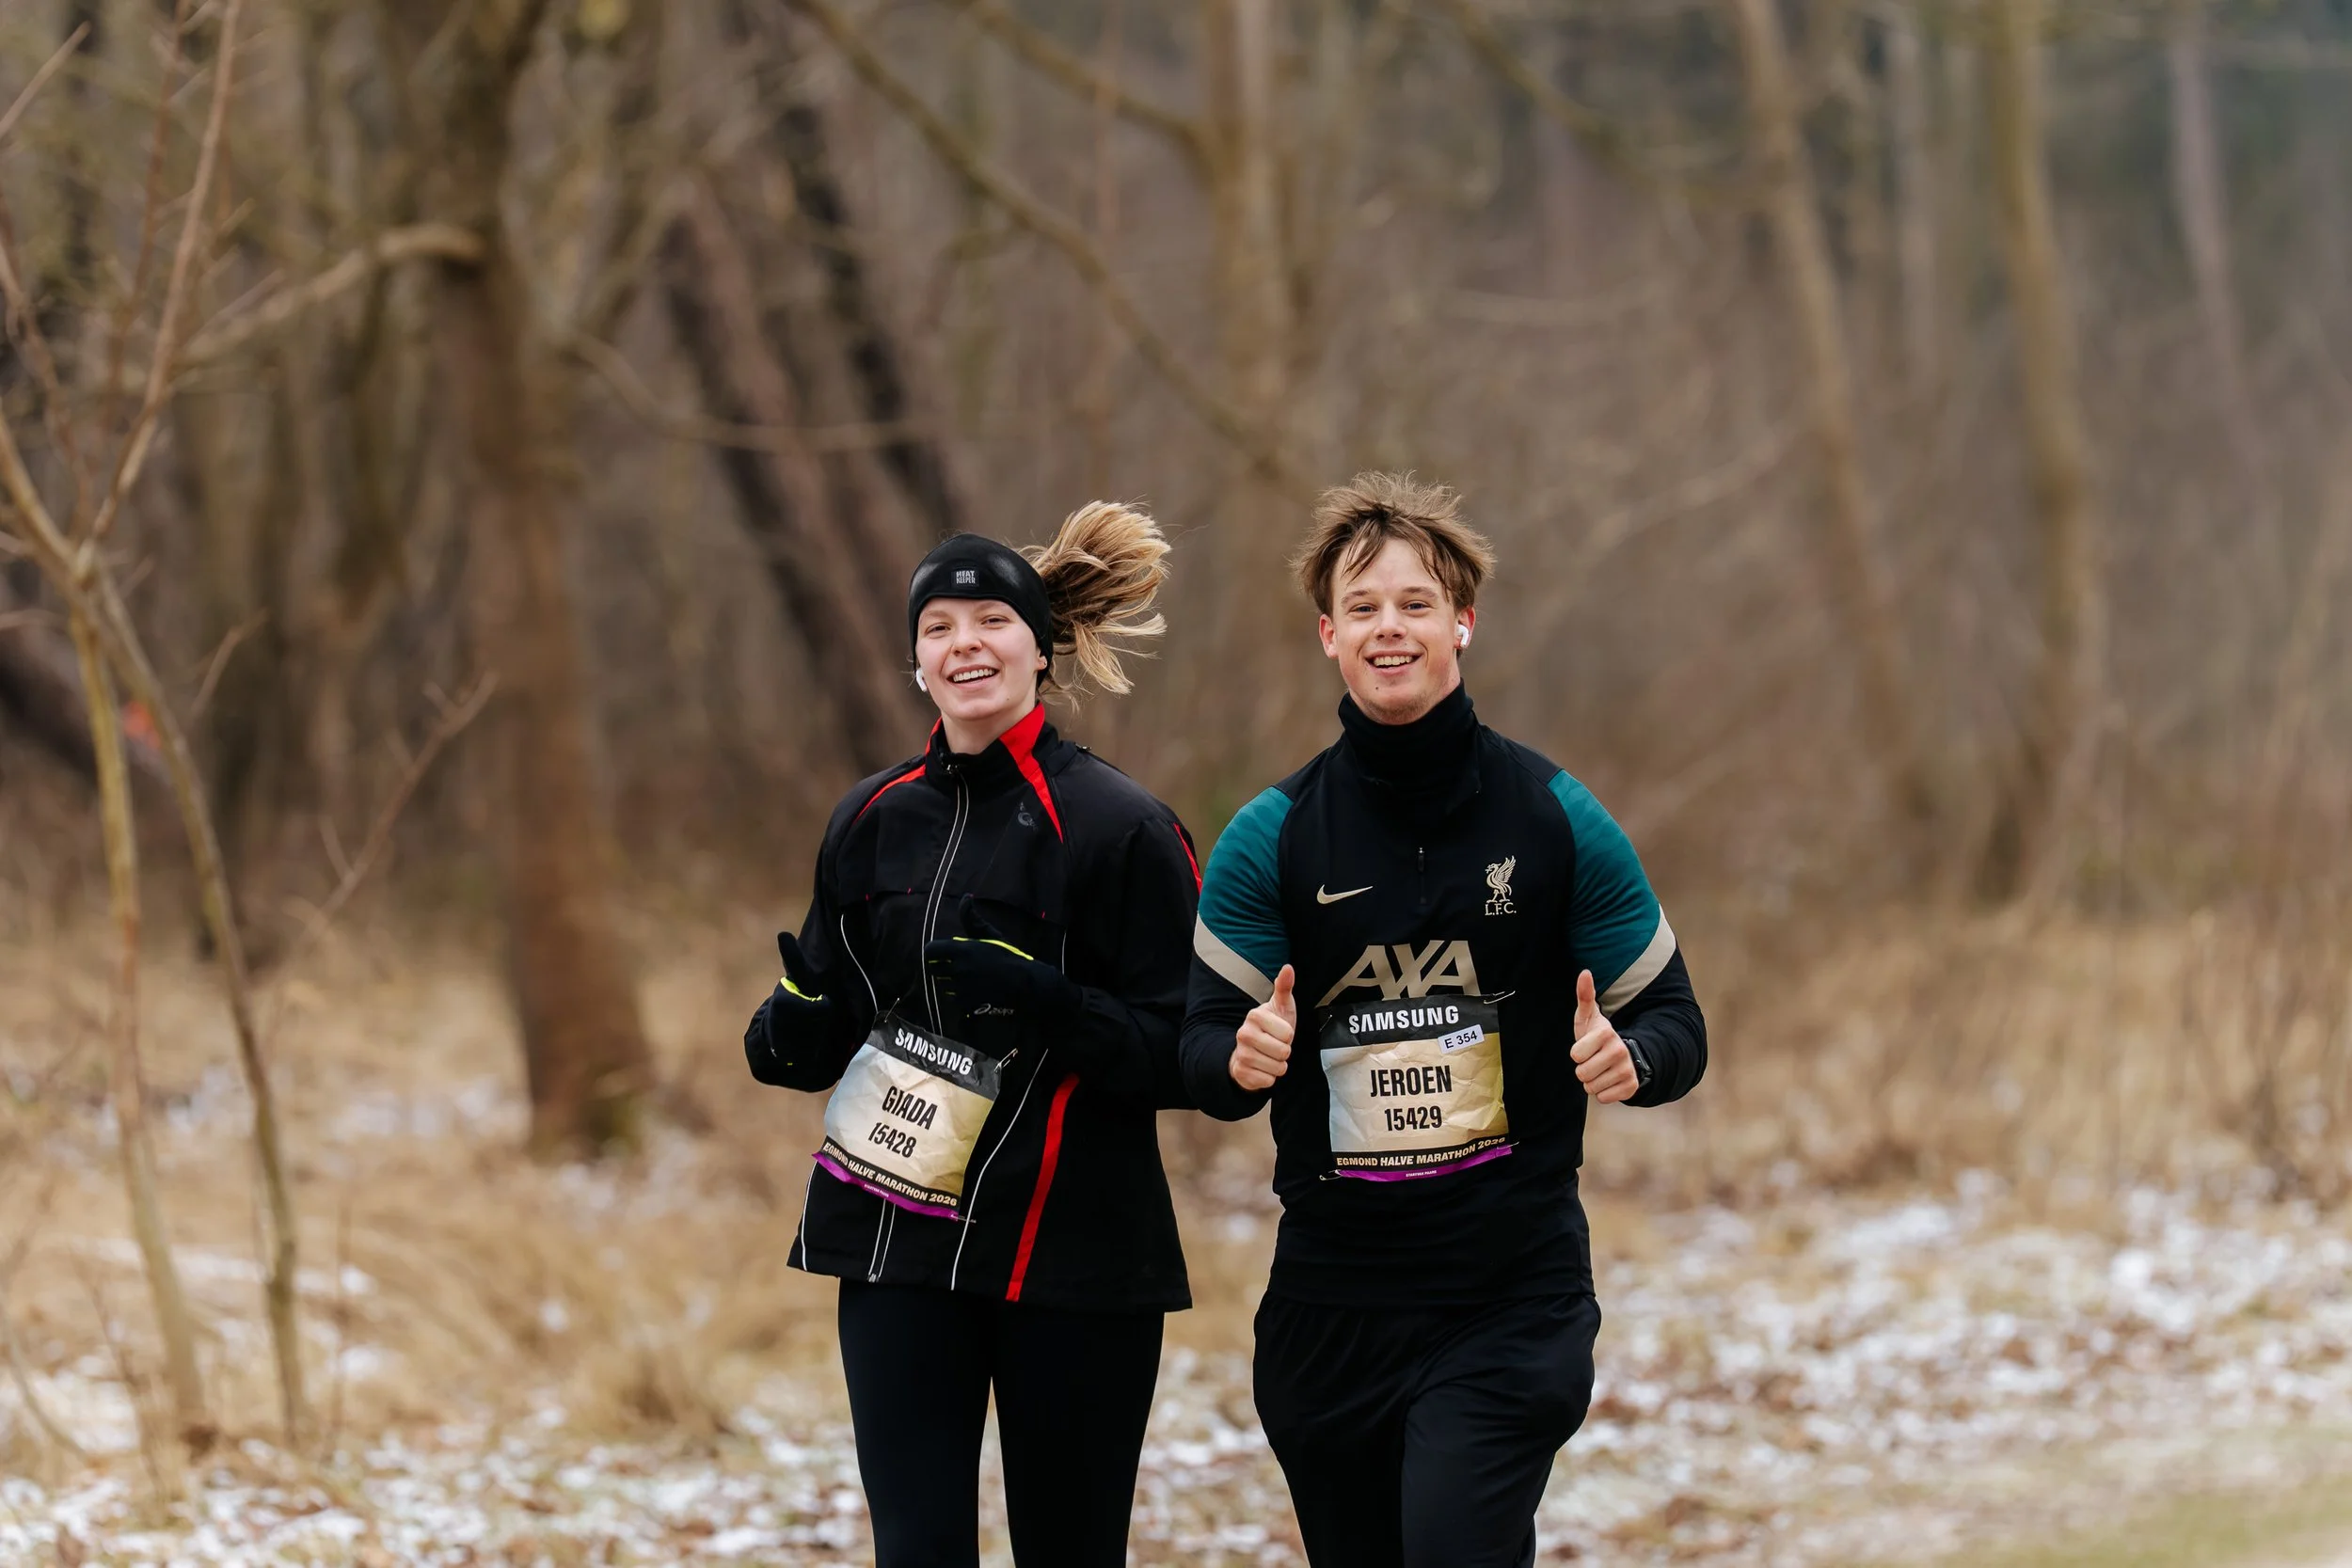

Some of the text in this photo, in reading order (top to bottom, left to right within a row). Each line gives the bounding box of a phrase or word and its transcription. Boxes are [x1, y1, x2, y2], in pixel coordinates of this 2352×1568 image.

[1485, 901, 1518, 916] L.F.C.
[1313, 940, 1482, 1008] AXA
[1348, 1005, 1460, 1035] SAMSUNG
[895, 1027, 974, 1076] SAMSUNG
[1444, 1031, 1479, 1050] E 354
[1370, 1065, 1453, 1098] JEROEN
[882, 1085, 939, 1131] GIADA
[1384, 1105, 1442, 1132] 15429
[868, 1121, 918, 1159] 15428
[1336, 1136, 1506, 1166] EGMOND HALVE MARATHON 2026
[822, 1141, 849, 1166] EGMOND
[848, 1160, 877, 1180] HALVE
[875, 1173, 930, 1202] MARATHON
[929, 1193, 958, 1207] 2026
